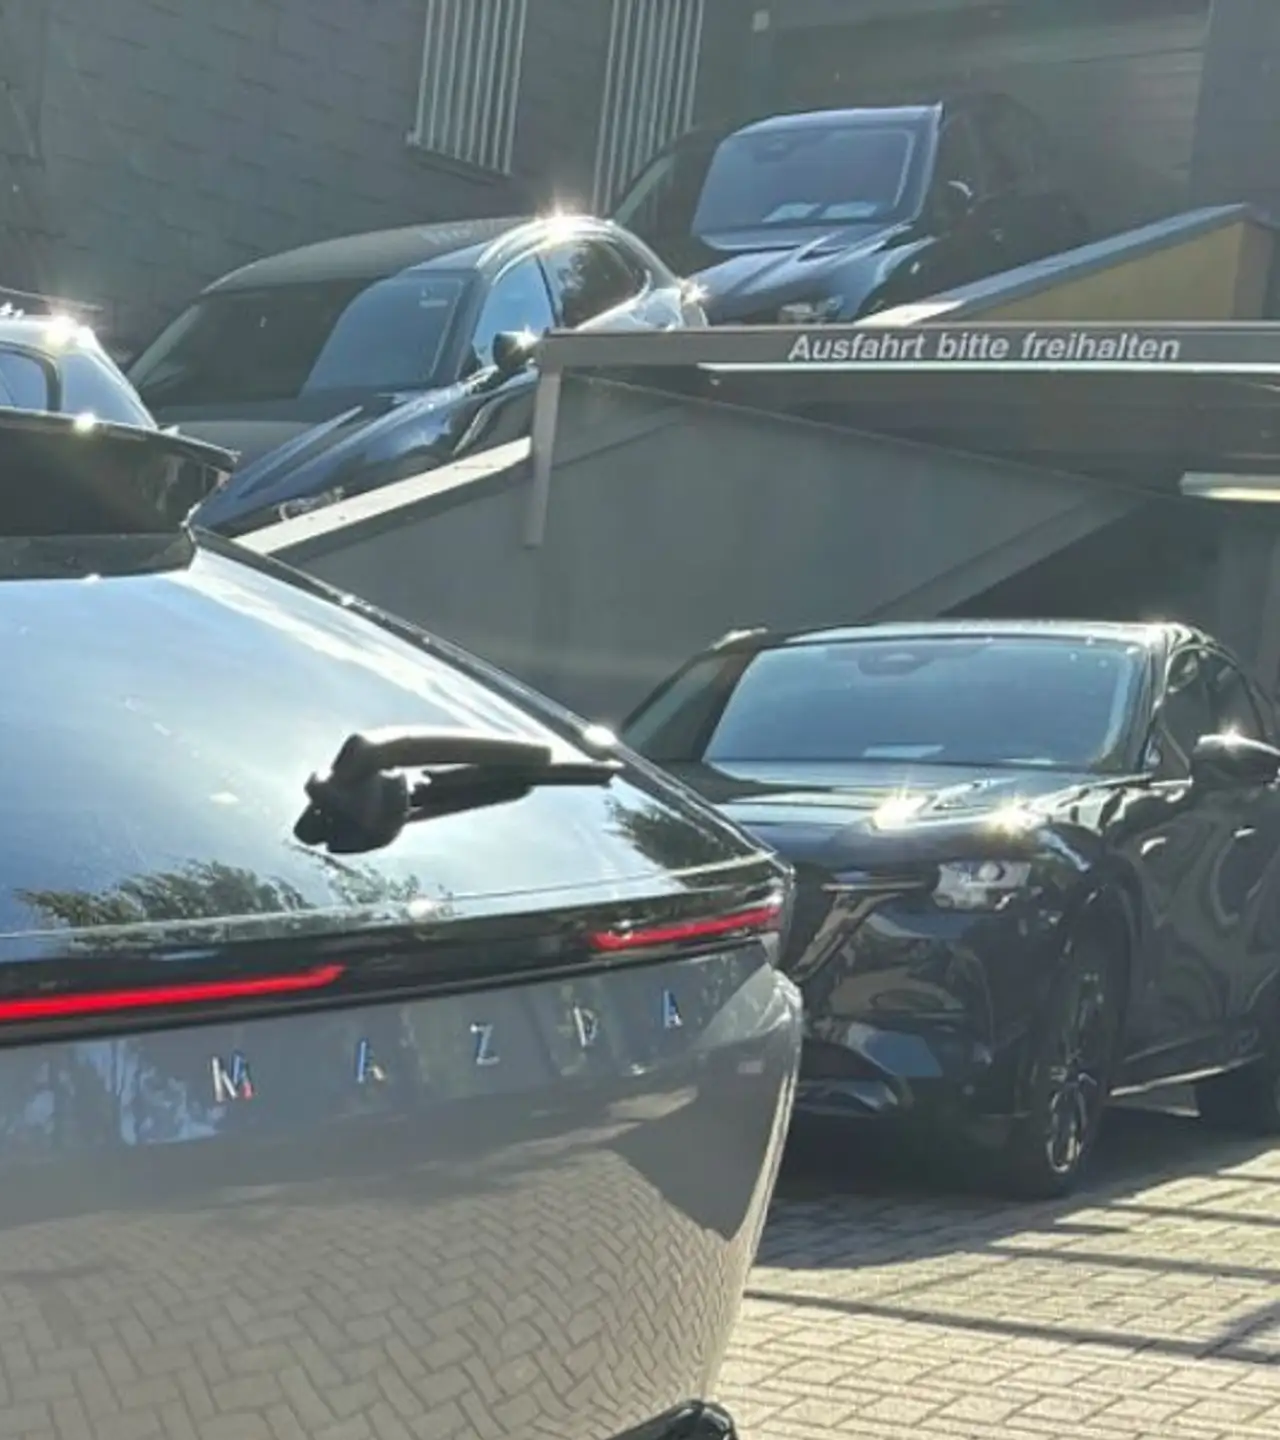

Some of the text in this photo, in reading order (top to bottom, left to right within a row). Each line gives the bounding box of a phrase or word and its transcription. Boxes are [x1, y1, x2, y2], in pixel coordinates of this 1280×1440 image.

[787, 331, 1181, 361] Ausfahrt bitte freihalten
[212, 989, 684, 1102] MAZDA
